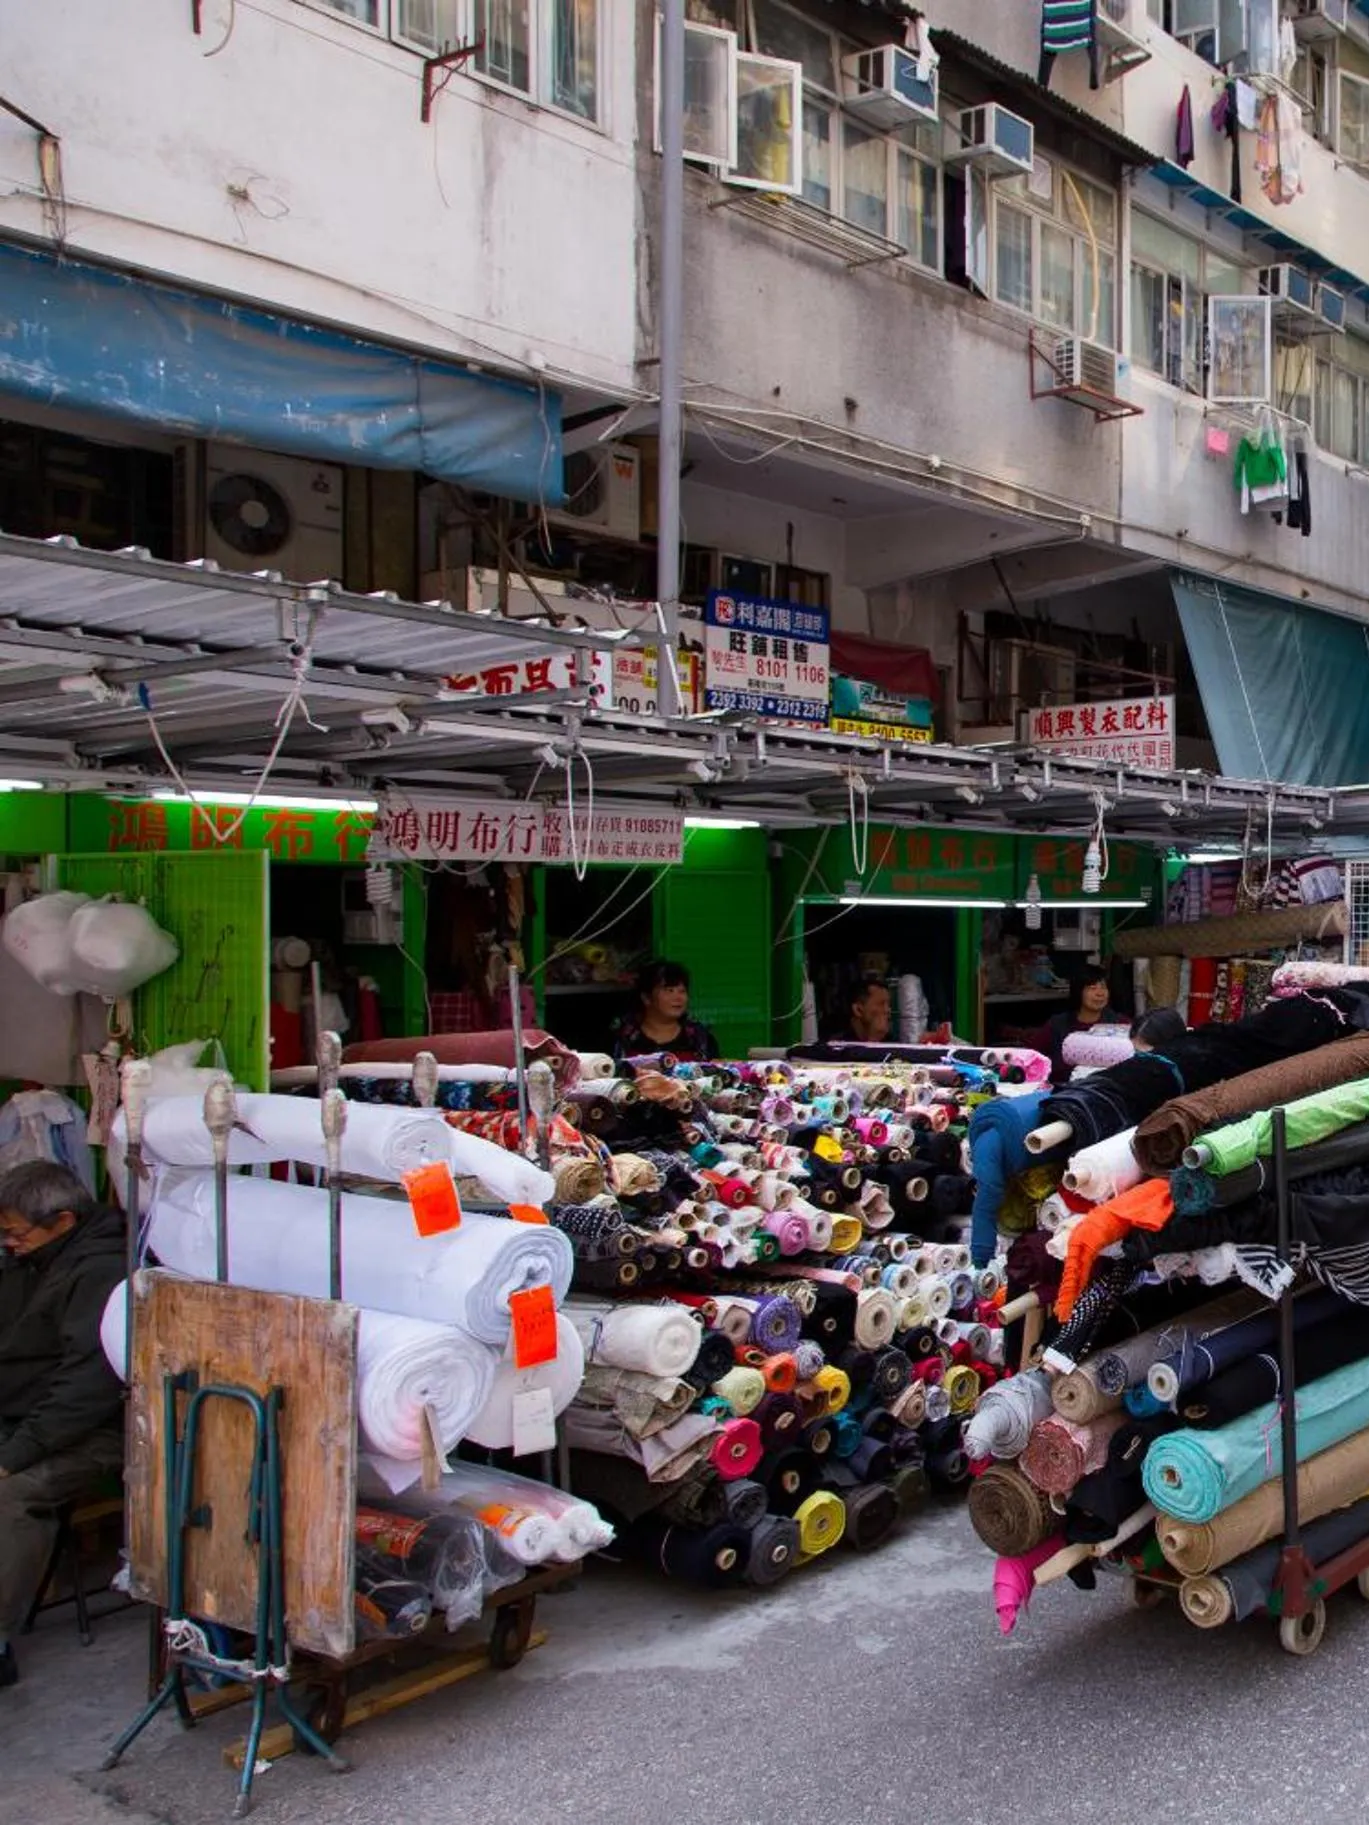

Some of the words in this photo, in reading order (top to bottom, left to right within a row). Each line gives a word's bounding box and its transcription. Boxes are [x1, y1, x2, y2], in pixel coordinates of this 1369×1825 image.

[756, 658, 788, 679] 8101
[796, 664, 826, 685] 1106
[1034, 702, 1169, 739] 順興製衣配料
[107, 799, 375, 863] 鴻明布行
[385, 807, 538, 855] 鴻明布行
